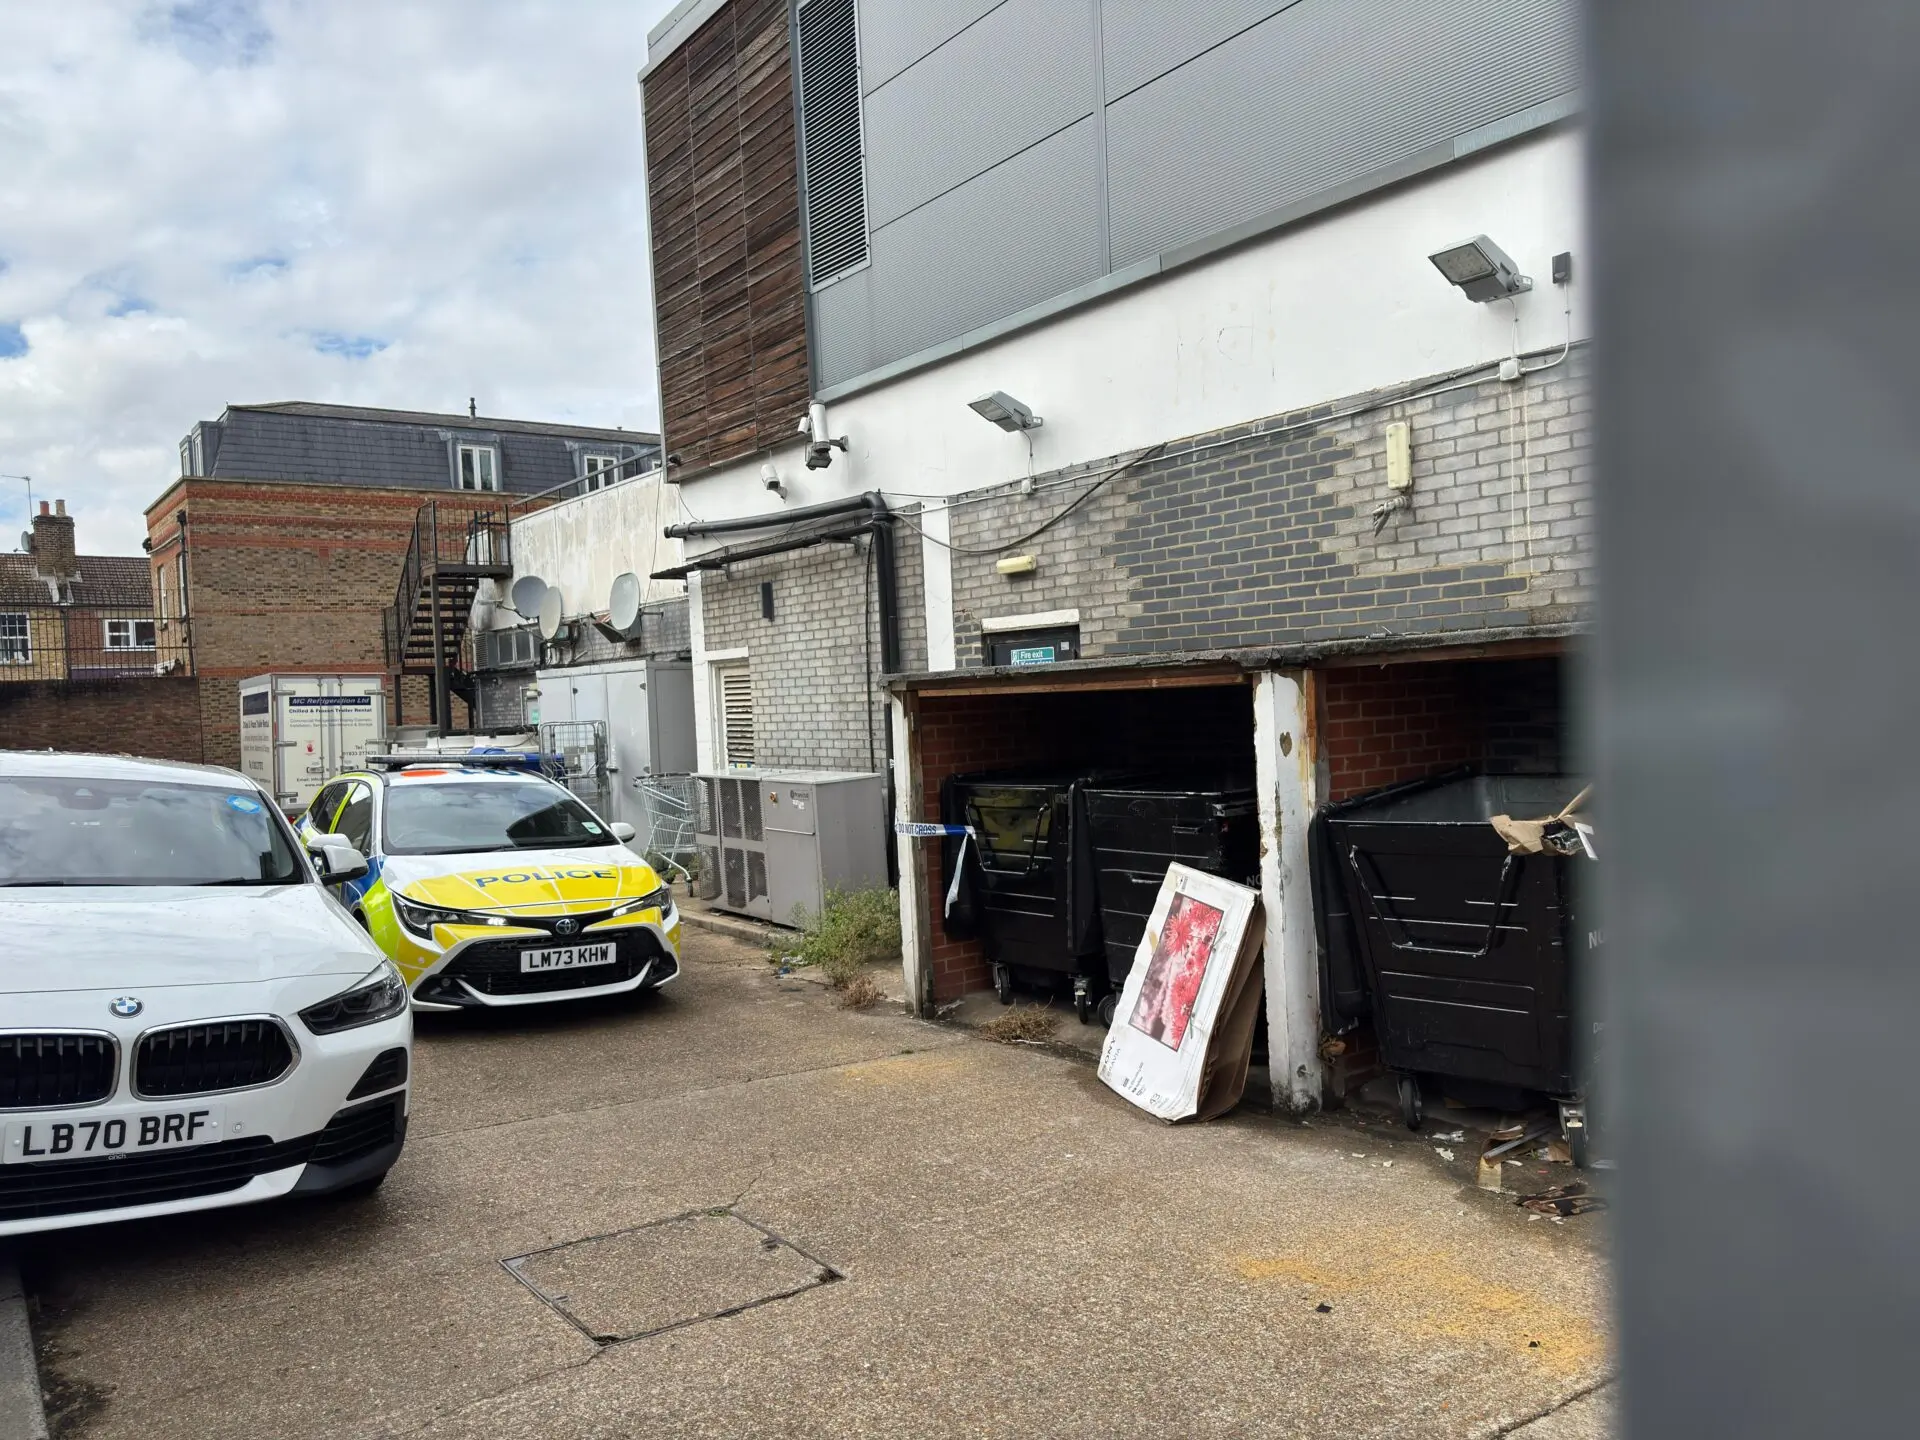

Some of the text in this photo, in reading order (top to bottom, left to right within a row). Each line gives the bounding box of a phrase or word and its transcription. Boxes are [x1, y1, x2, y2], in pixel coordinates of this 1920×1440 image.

[1020, 650, 1043, 659] Fire exit
[306, 697, 356, 706] Refrigeration
[898, 823, 905, 834] DO
[904, 824, 914, 835] NOT
[914, 824, 937, 835] CROSS
[474, 869, 617, 888] POLICE
[529, 945, 609, 969] LM73 KHW
[22, 1110, 210, 1157] LB70 BRF
